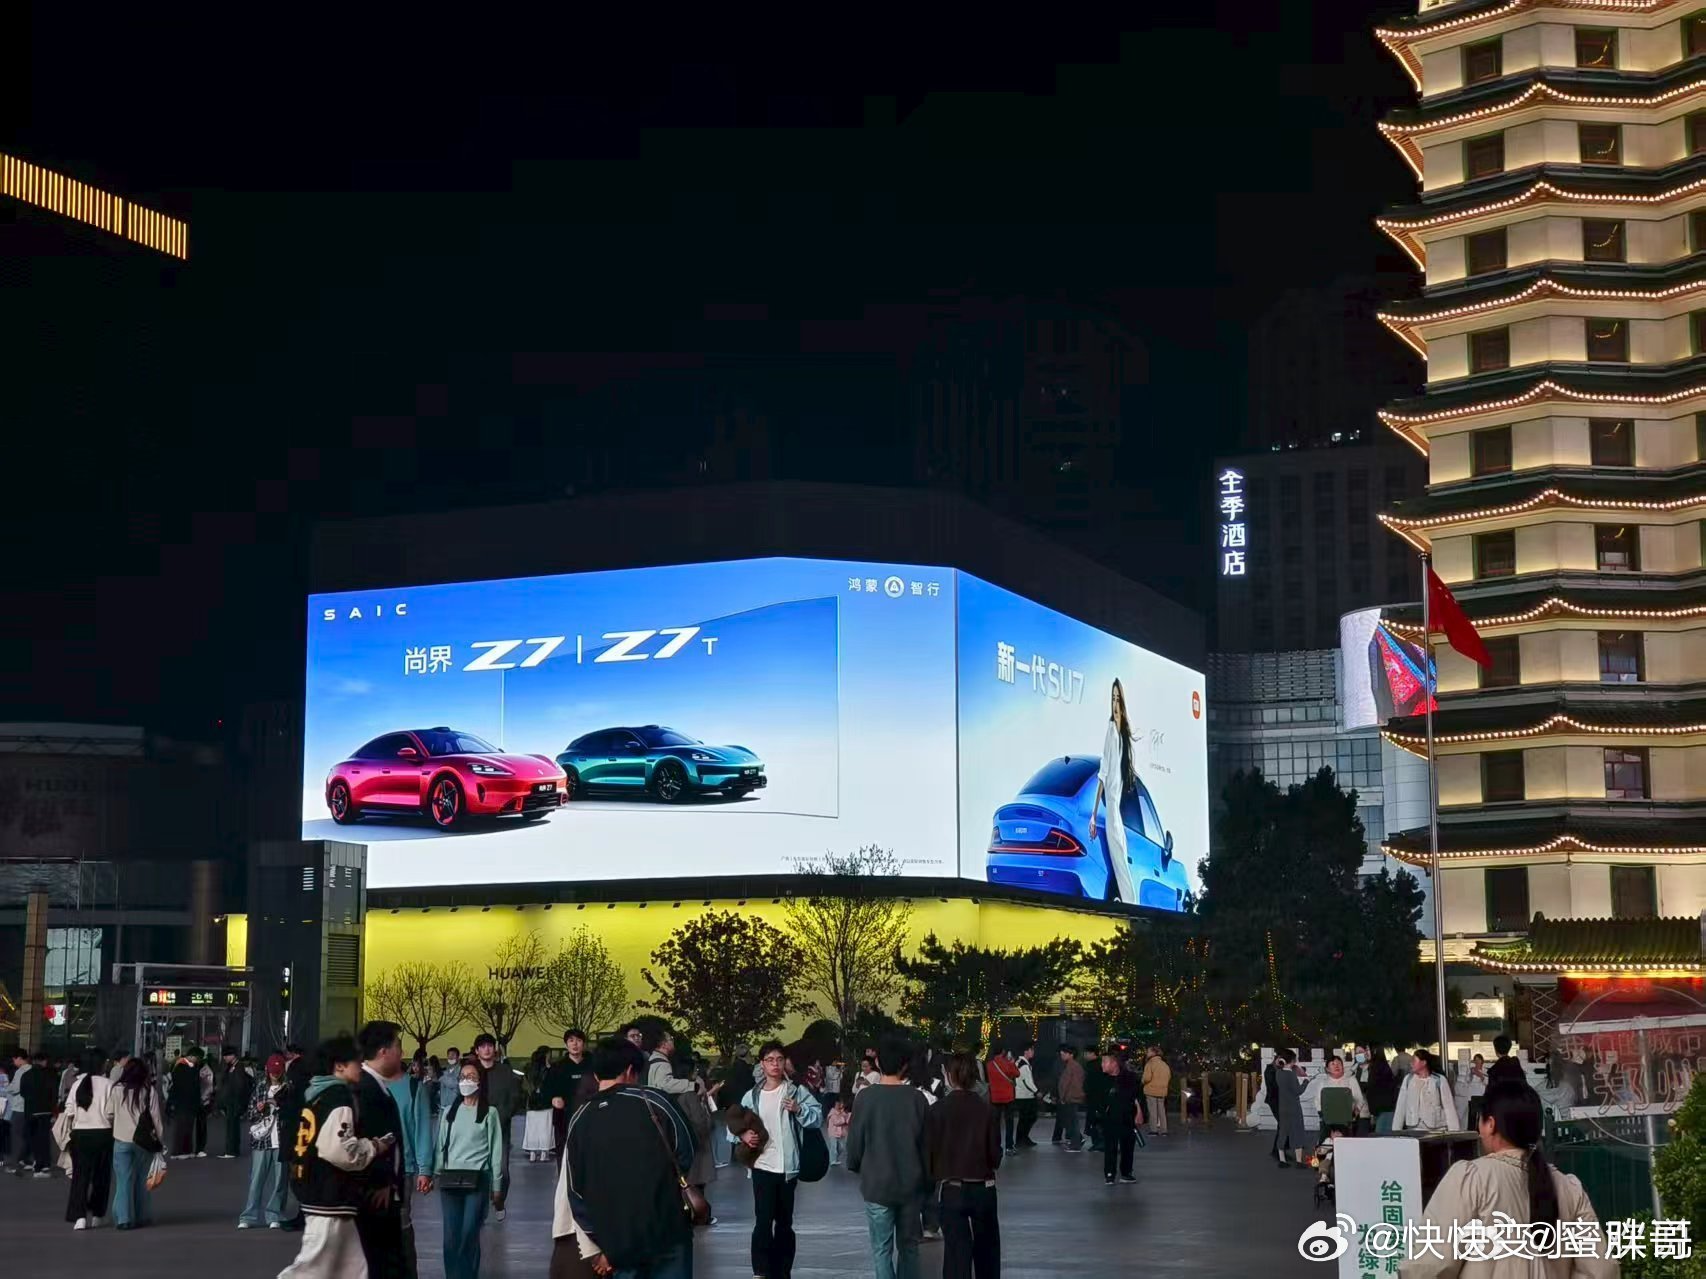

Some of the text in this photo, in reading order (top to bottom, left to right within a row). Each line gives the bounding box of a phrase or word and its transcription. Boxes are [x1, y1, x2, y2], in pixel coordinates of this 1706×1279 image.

[1219, 470, 1246, 576] 全季酒店
[848, 577, 941, 597] 鸿蒙 智行
[324, 603, 407, 620] SAIC
[404, 645, 453, 675] 尚界
[462, 636, 566, 672] Z7
[997, 640, 1085, 705] 新一代SU7
[489, 966, 550, 980] HUAWEI
